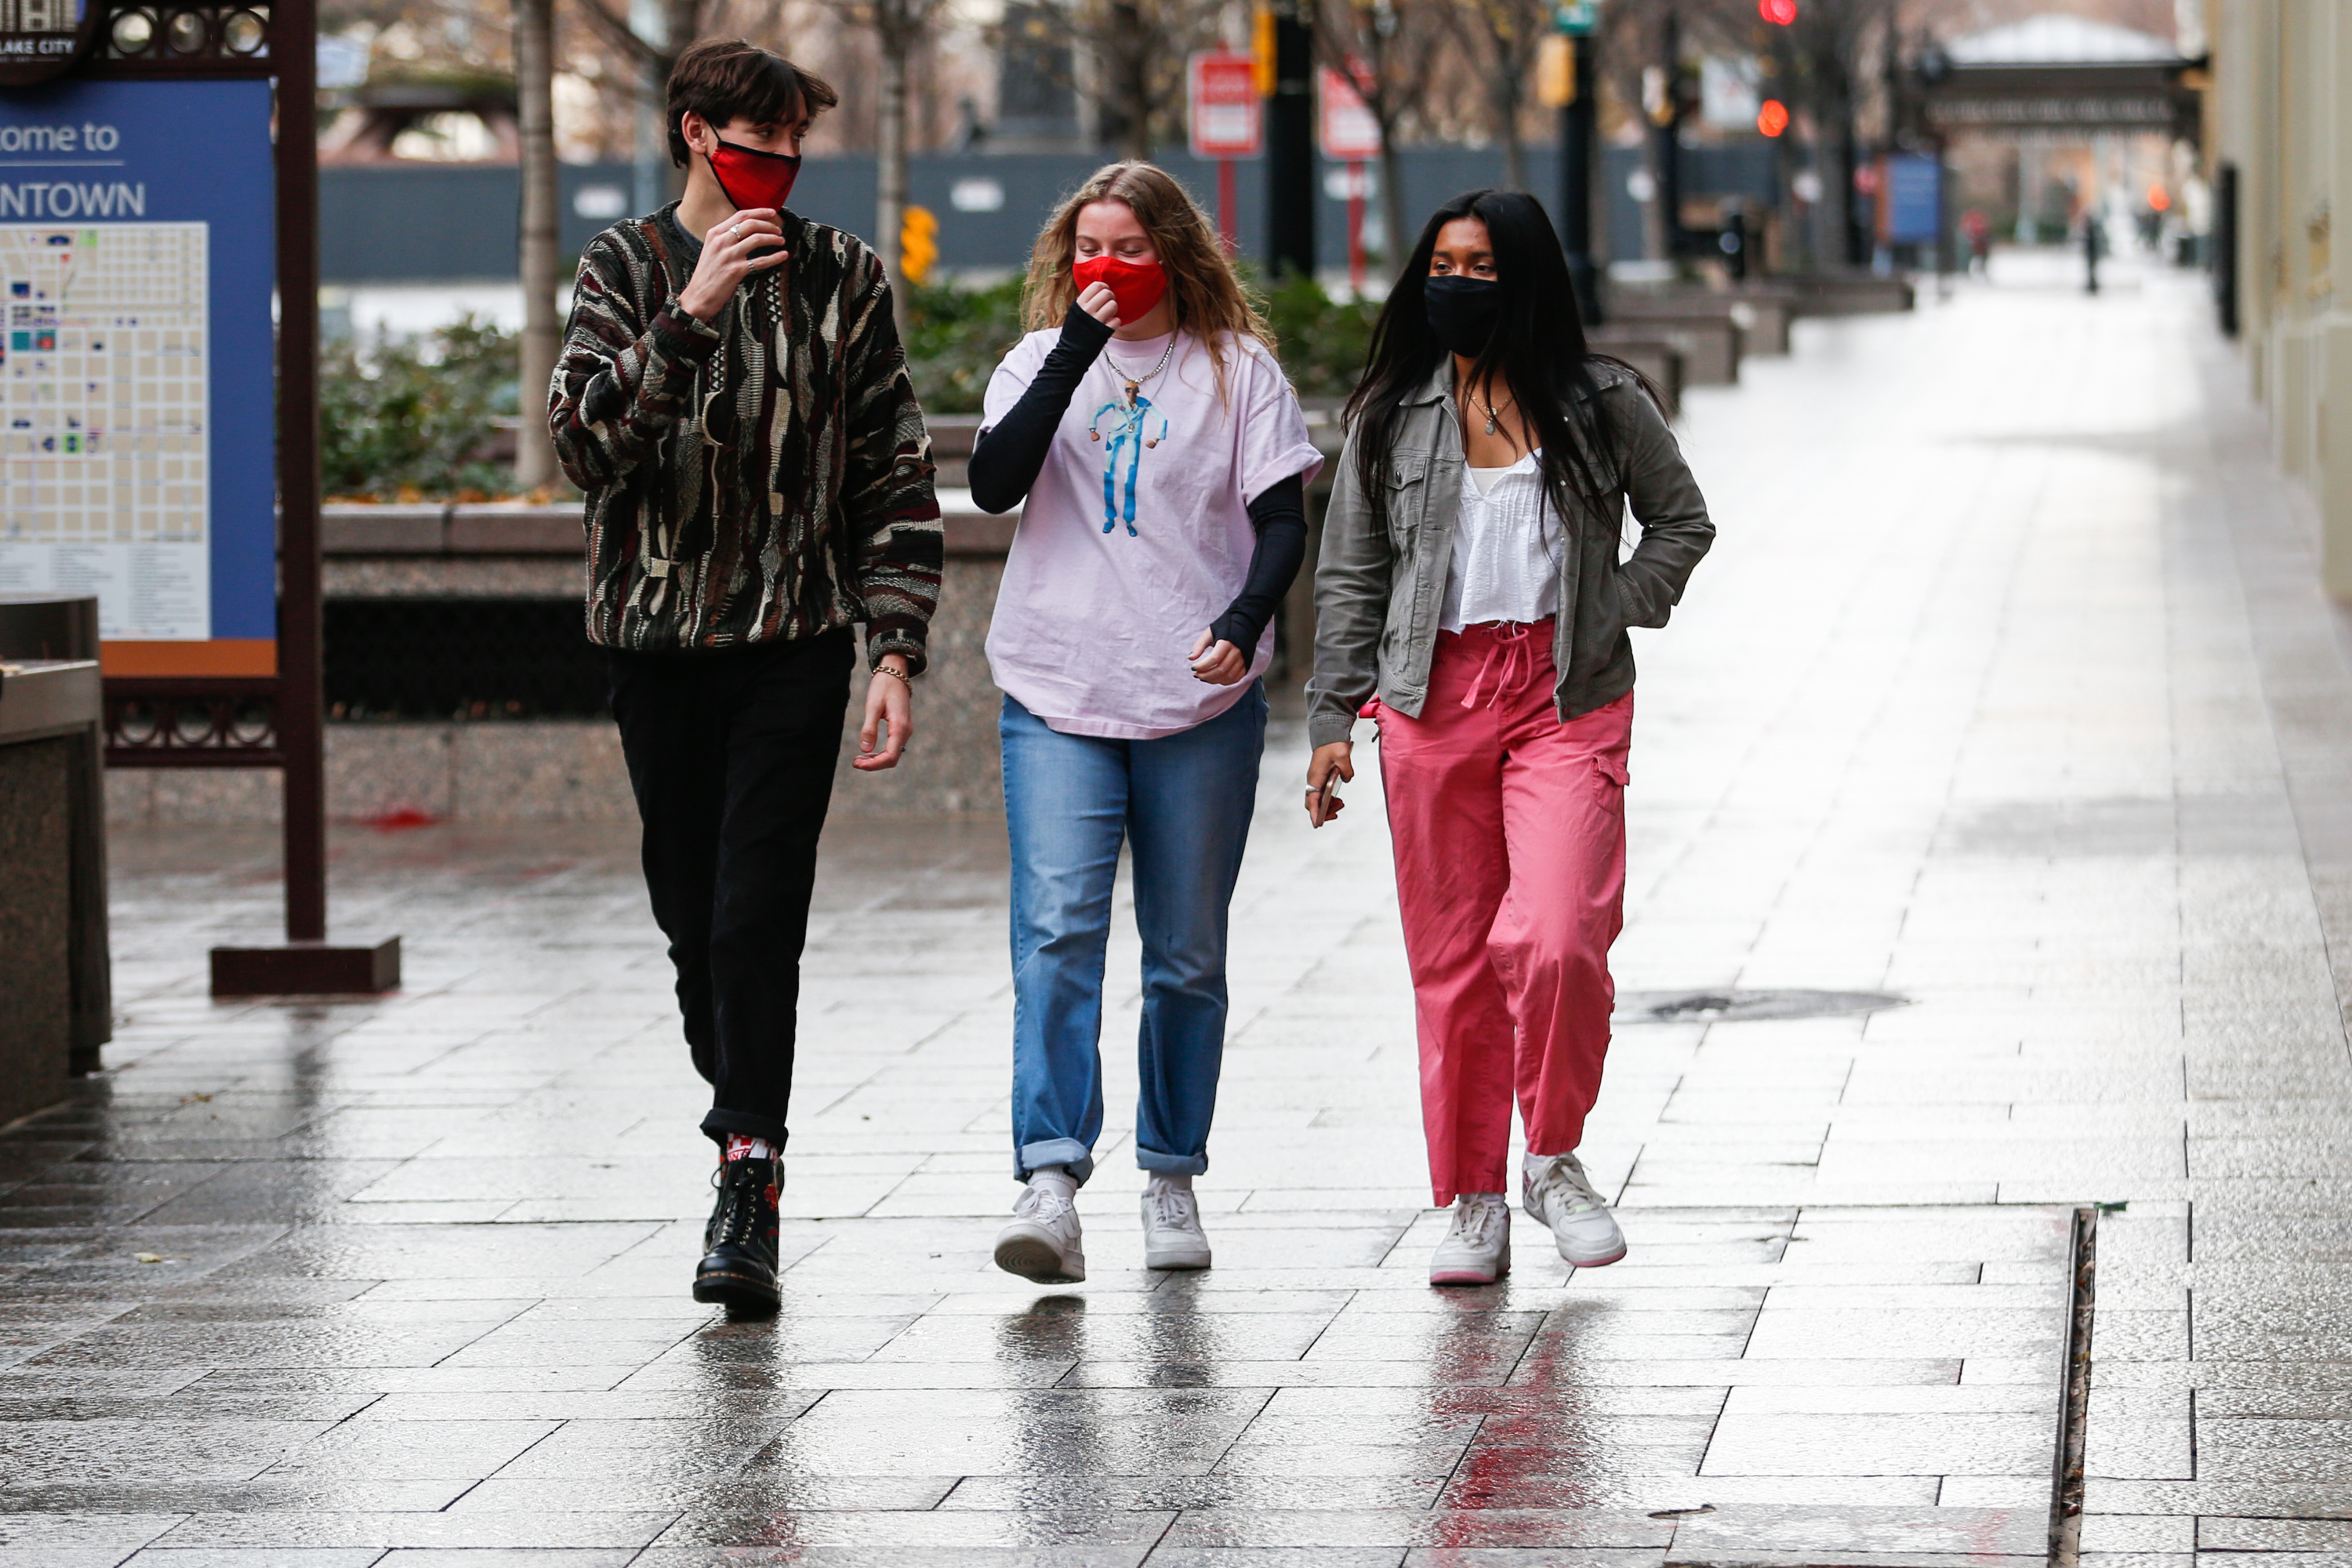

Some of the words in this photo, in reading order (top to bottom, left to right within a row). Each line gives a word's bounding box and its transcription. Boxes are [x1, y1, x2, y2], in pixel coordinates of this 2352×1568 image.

[38, 38, 76, 55] CITY
[0, 125, 78, 151] ome
[82, 122, 120, 151] to
[0, 182, 147, 218] NTOWN
